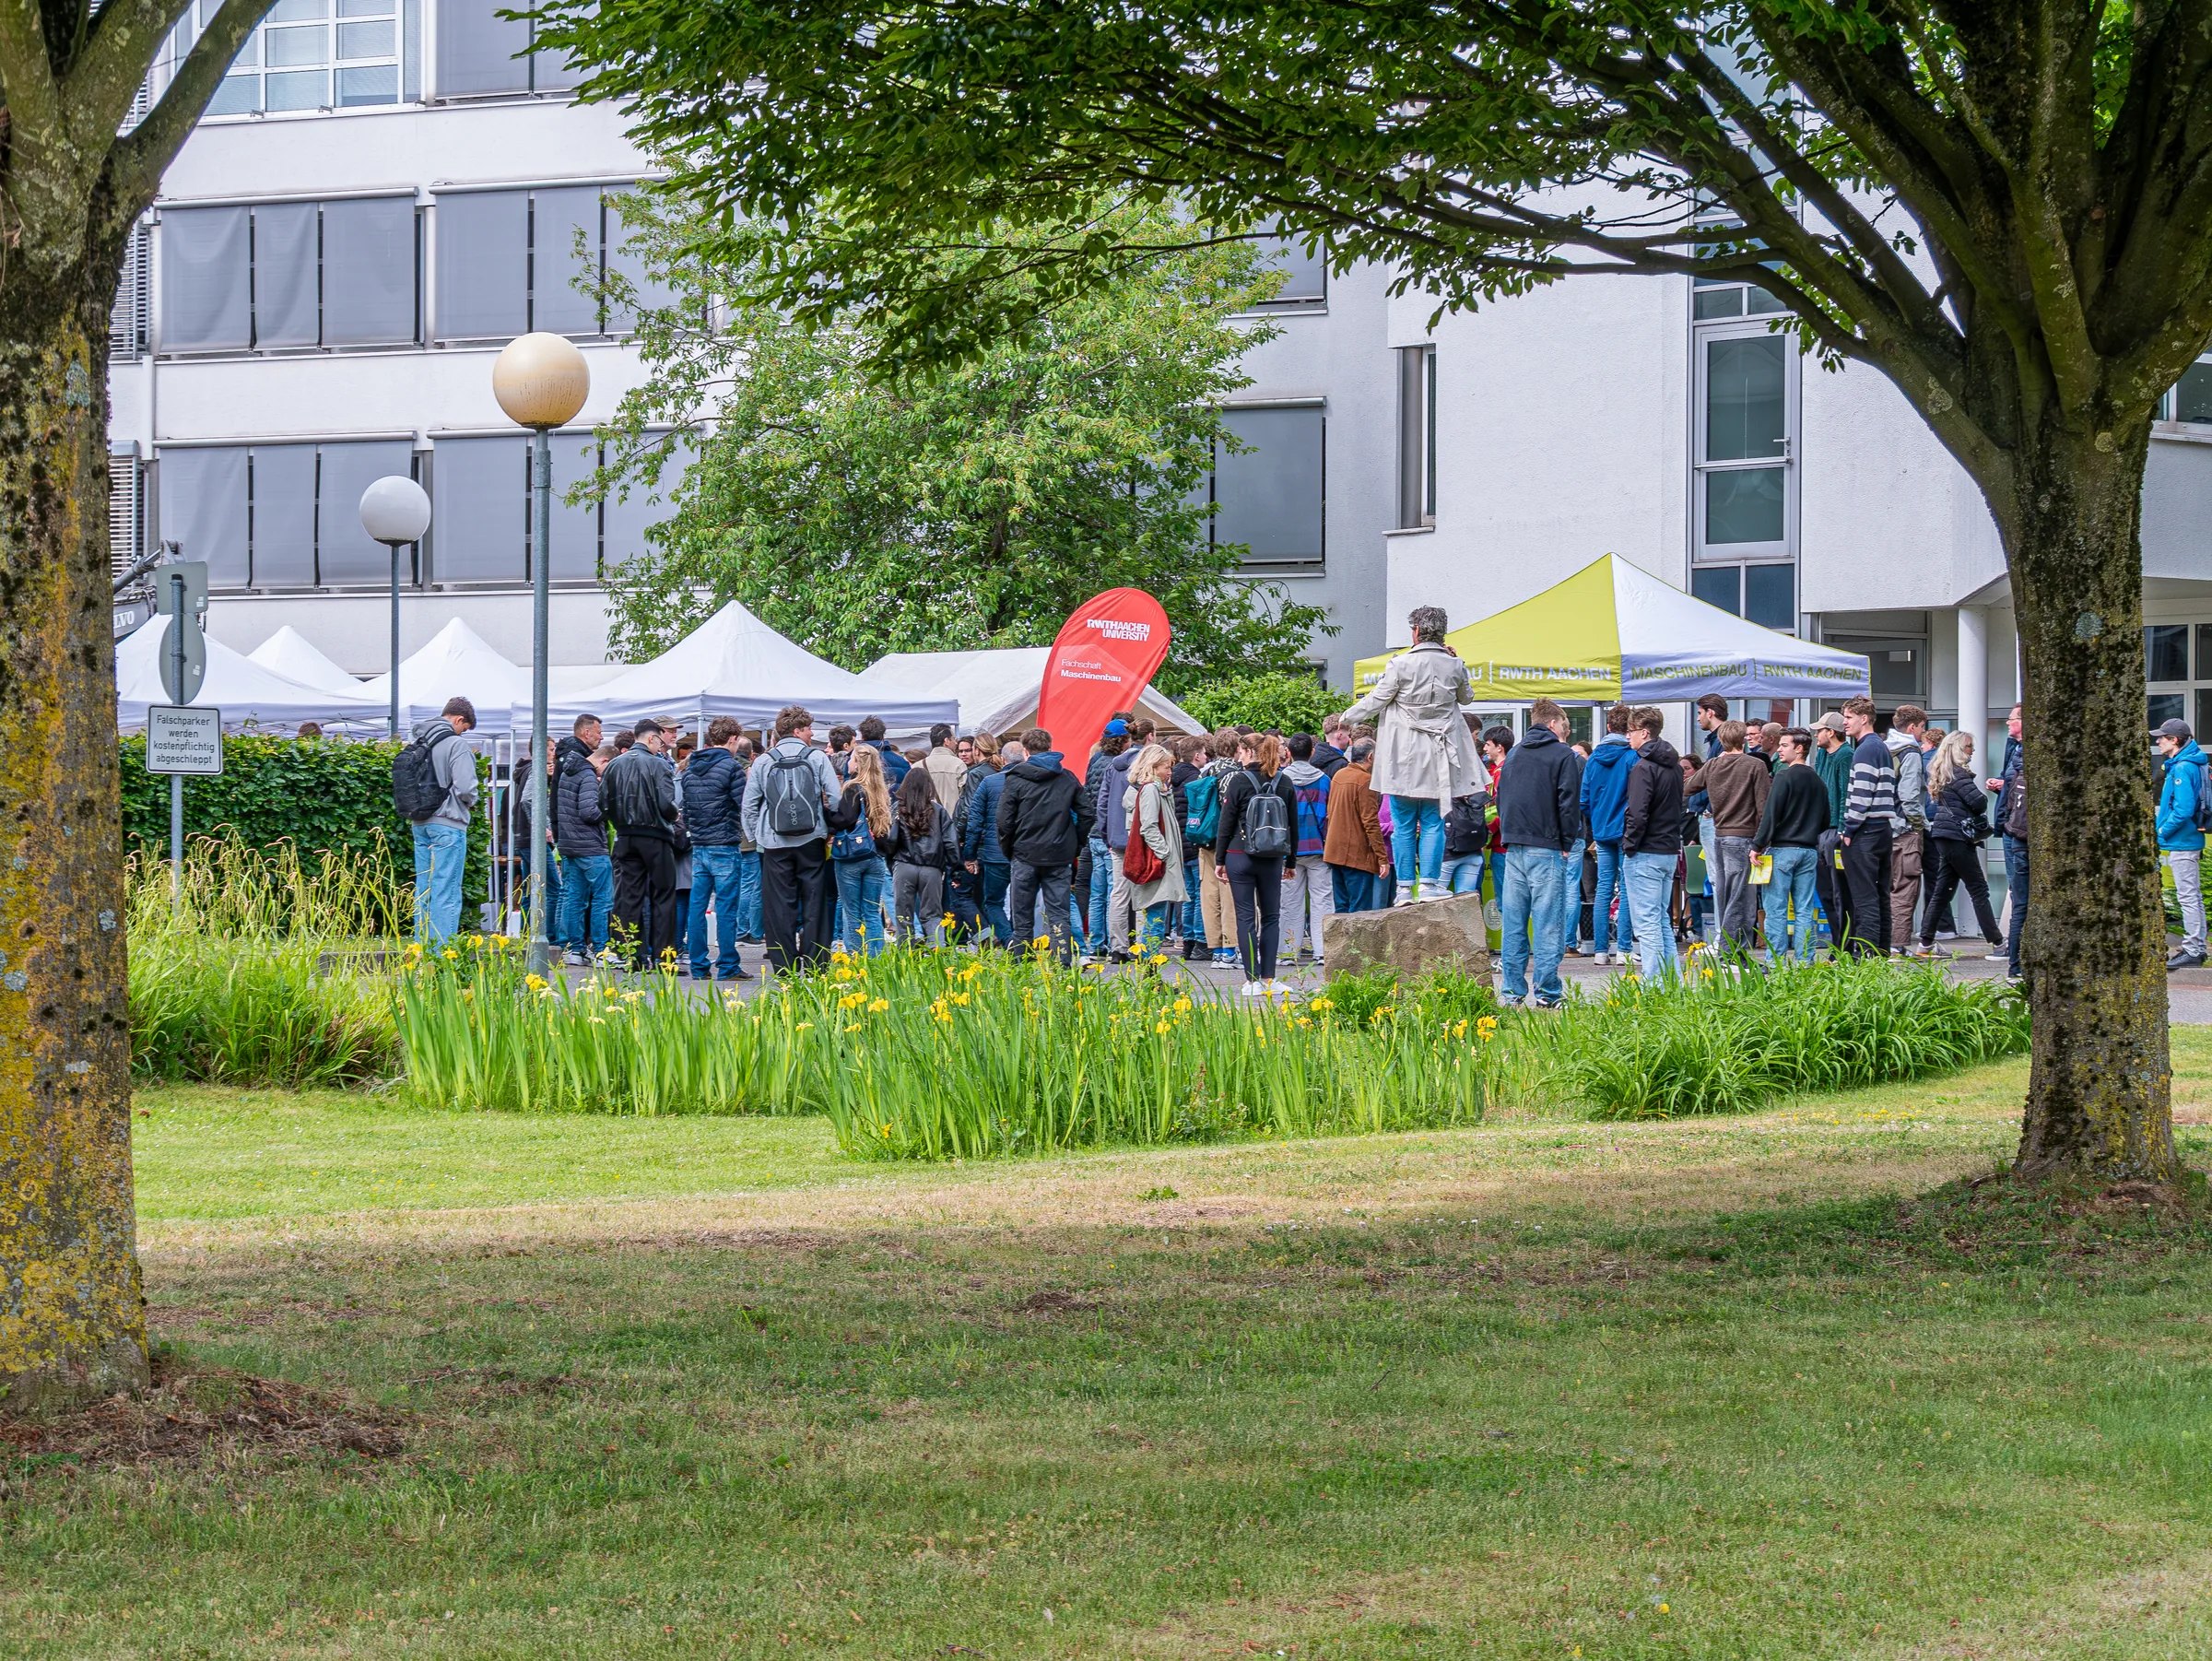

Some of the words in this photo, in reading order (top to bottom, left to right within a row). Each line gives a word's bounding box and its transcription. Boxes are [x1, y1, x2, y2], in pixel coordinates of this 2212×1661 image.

[112, 610, 135, 629] LVO
[1102, 629, 1149, 642] UNIVERSITY
[1061, 658, 1102, 670] Fachschaft
[1060, 670, 1122, 682] Maschinenbau
[1500, 666, 1544, 680] RWTH
[1547, 666, 1611, 680] AACHEN
[1630, 664, 1747, 680] MASCHINENBAU
[1763, 664, 1803, 678] RWTH
[1806, 666, 1862, 681] AACHEN
[157, 714, 211, 726] Falschparker
[168, 729, 199, 738] werden
[153, 740, 215, 753] kostenpflichtig
[156, 754, 212, 766] abgeschleppt
